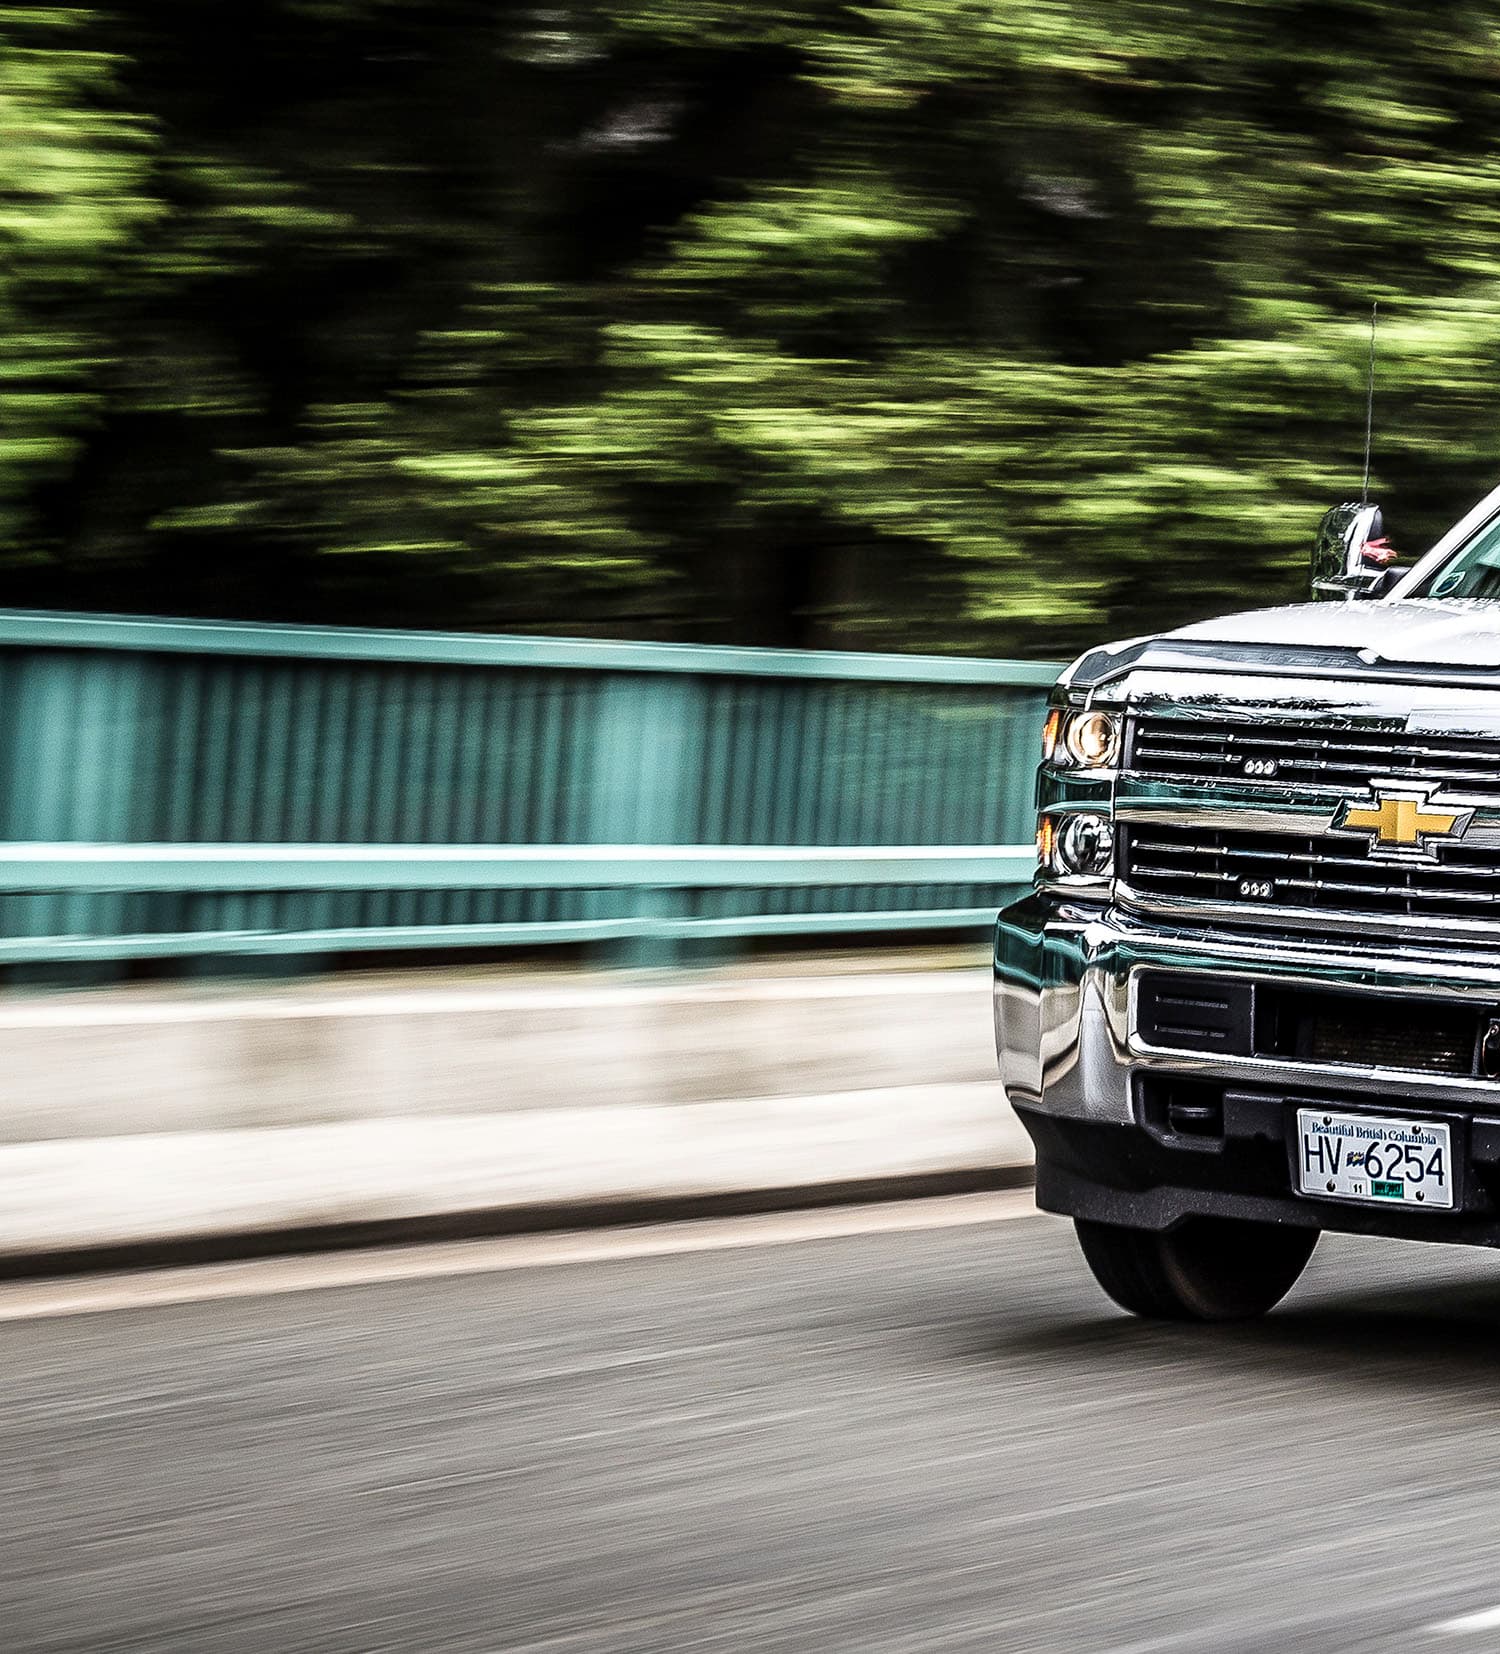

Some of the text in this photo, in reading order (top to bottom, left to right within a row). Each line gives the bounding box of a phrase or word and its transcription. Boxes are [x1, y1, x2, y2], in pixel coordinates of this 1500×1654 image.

[1311, 1121, 1437, 1145] Beautiful British Columbia
[1304, 1134, 1445, 1186] HV 6254
